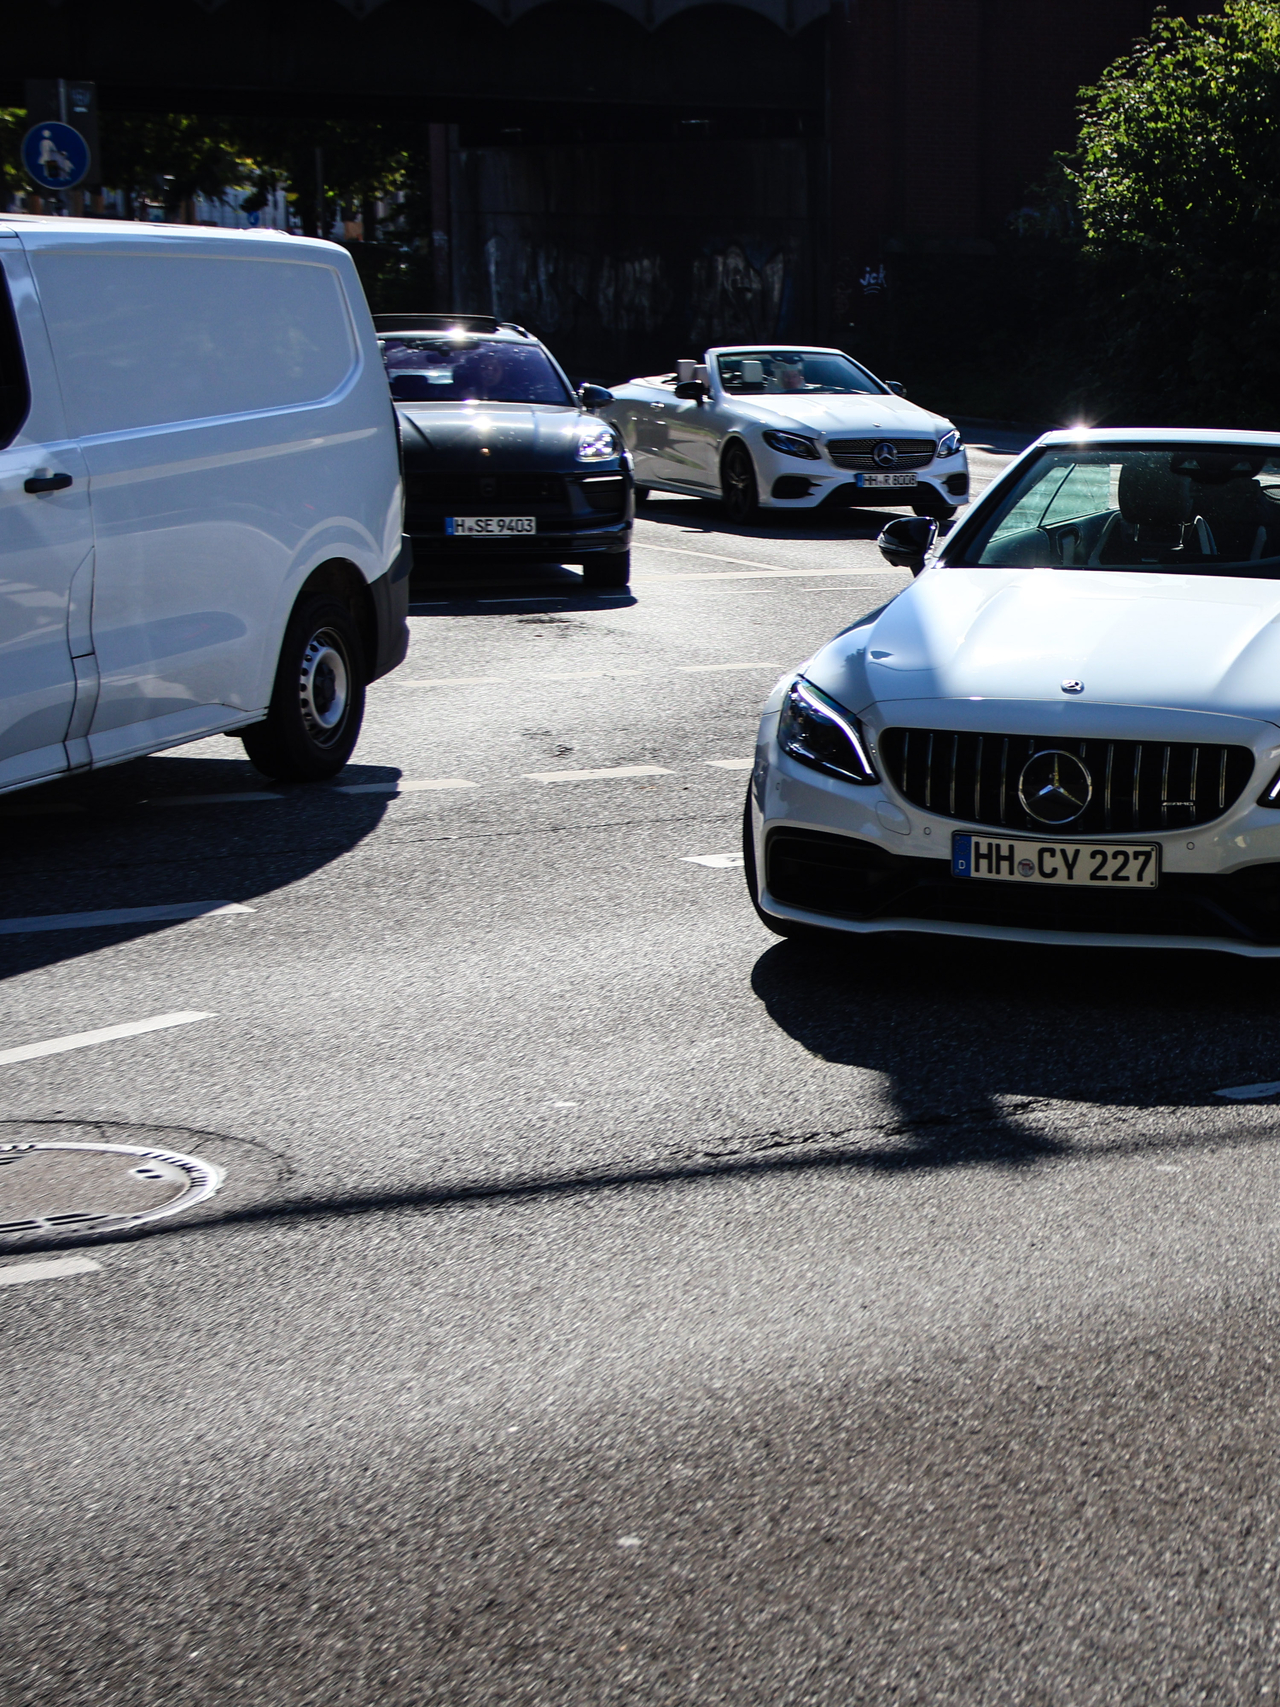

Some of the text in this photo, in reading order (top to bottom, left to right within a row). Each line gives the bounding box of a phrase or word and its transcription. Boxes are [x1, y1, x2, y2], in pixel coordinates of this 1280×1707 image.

[455, 518, 534, 533] H SE 9403
[957, 859, 966, 870] D
[973, 841, 1153, 882] HH CY 227
